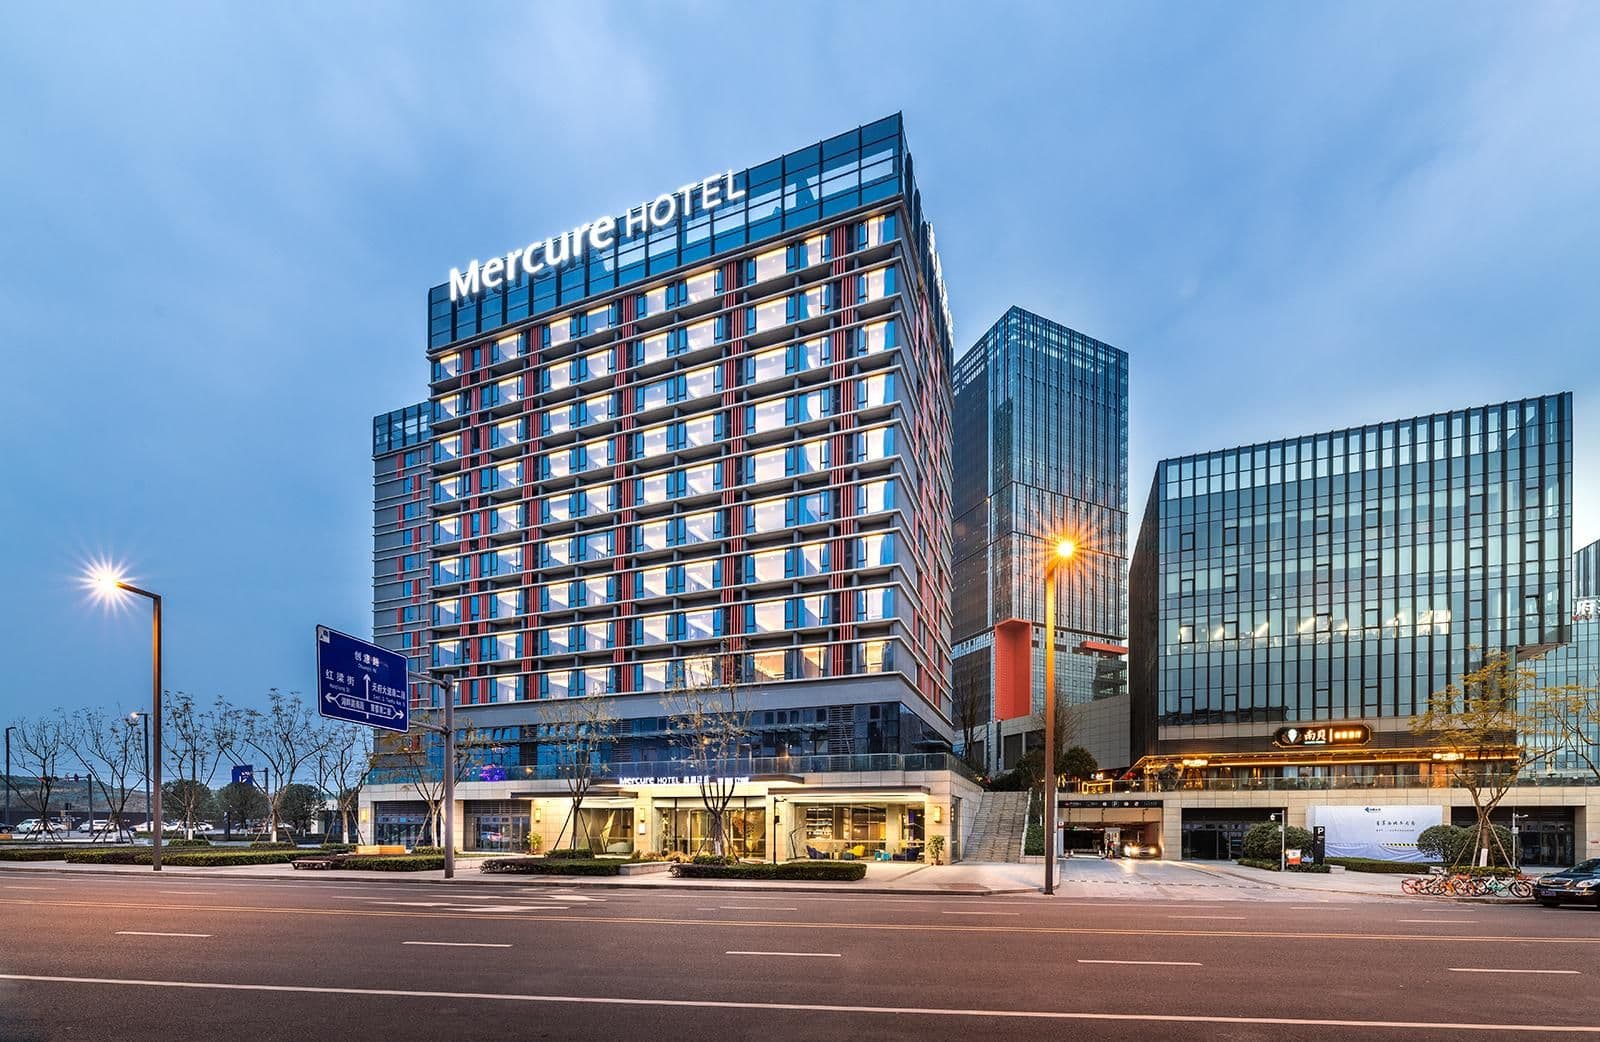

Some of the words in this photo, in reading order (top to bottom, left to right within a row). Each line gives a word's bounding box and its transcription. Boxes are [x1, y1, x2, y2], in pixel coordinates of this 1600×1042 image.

[449, 215, 615, 301] Mercure
[625, 168, 746, 237] HOTEL
[620, 777, 655, 785] Mercure
[657, 777, 680, 785] HOTEL
